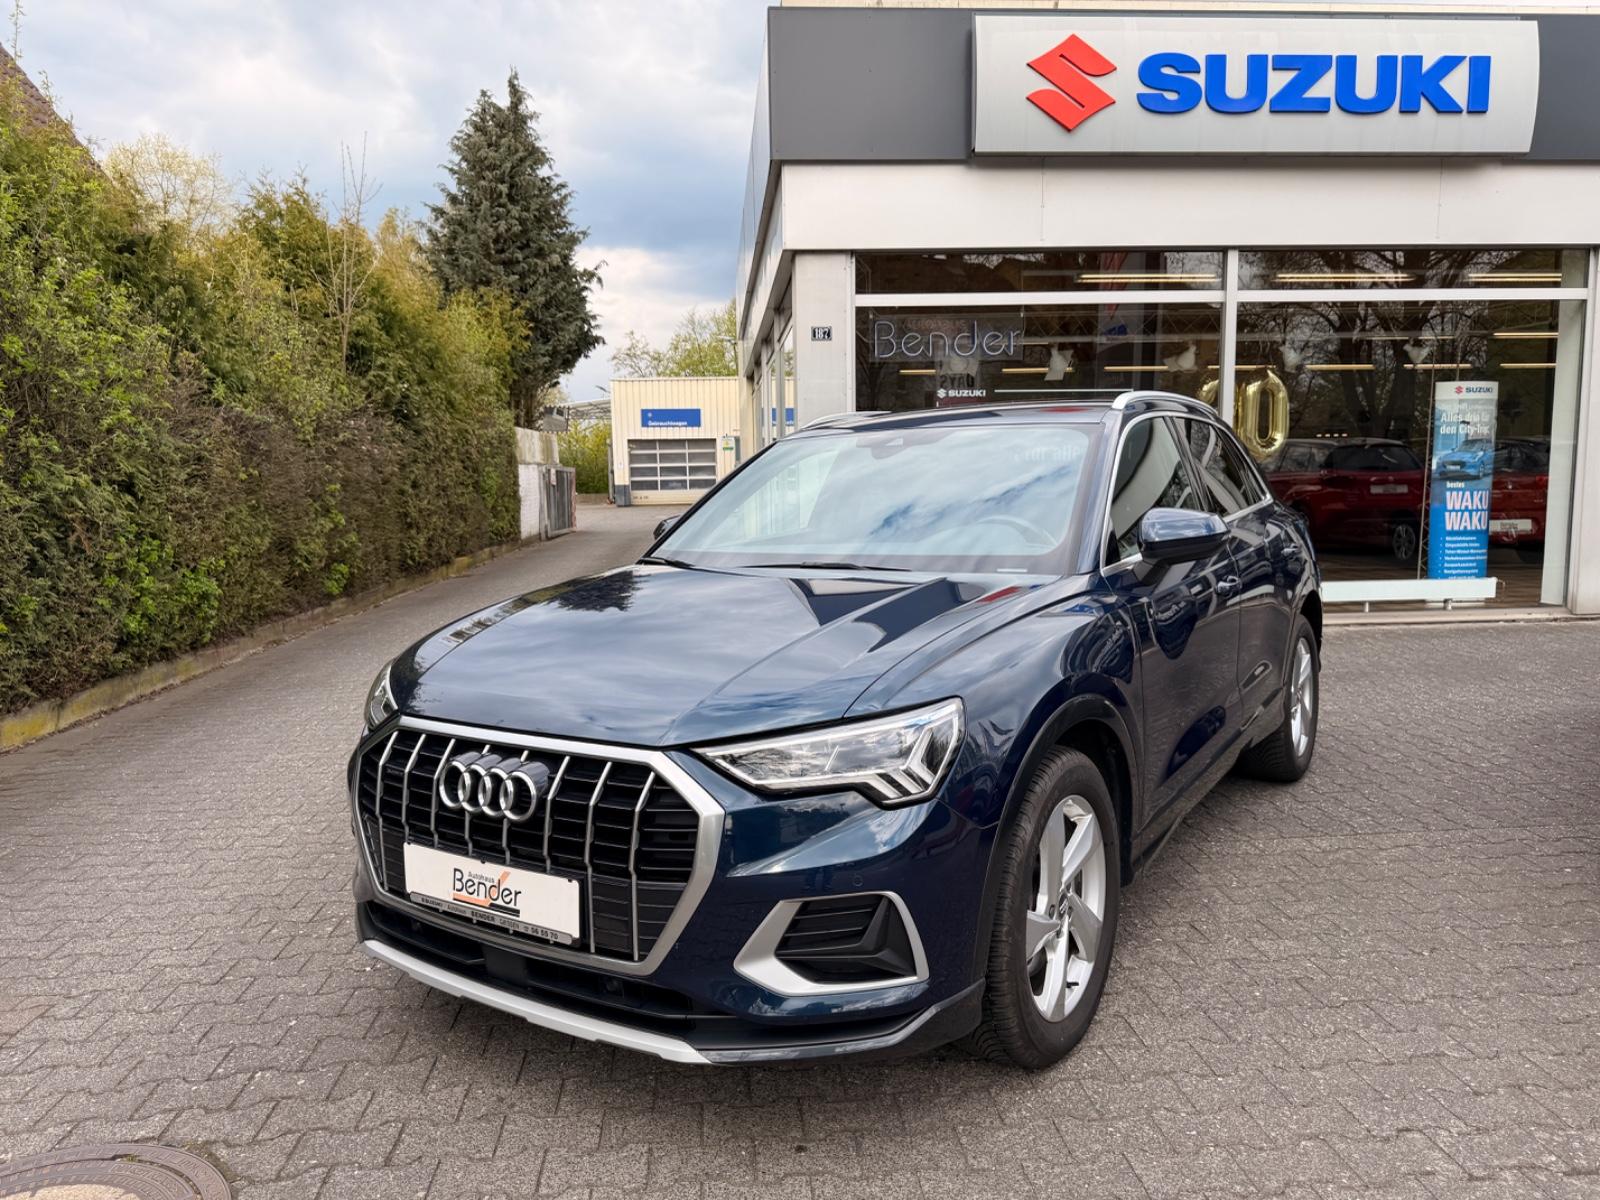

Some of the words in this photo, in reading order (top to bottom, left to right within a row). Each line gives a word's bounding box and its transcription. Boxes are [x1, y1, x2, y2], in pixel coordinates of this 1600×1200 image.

[1136, 52, 1492, 114] SUZUKI
[815, 327, 829, 340] 187
[874, 320, 1021, 358] Bender
[948, 389, 986, 397] SUZUKI
[1465, 386, 1493, 394] SUZUKI
[1440, 410, 1463, 422] Alles
[1440, 424, 1457, 435] den
[1445, 490, 1489, 511] WAKU
[1444, 511, 1488, 531] WAKU
[468, 871, 495, 884] Autohaus
[453, 867, 522, 907] Bender
[471, 910, 496, 922] BENDER
